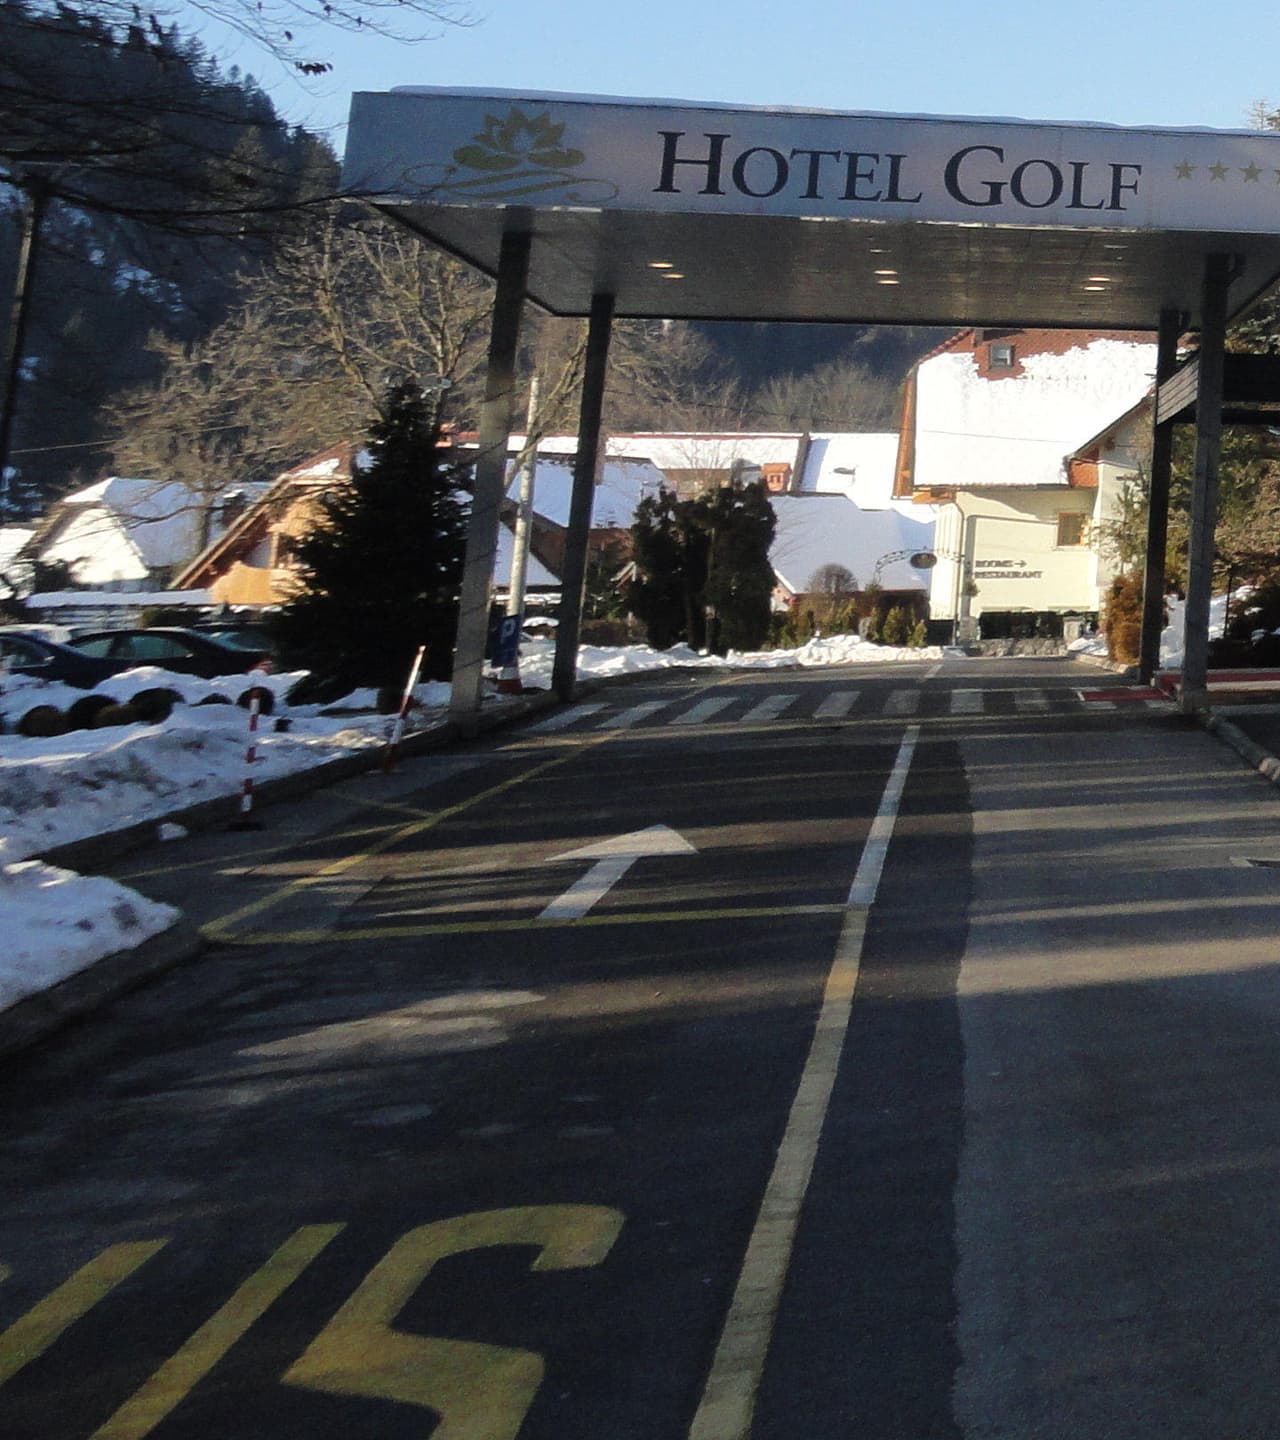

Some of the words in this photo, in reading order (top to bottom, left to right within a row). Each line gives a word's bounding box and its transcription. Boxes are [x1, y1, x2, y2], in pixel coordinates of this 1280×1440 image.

[652, 130, 922, 205] HOTEL
[944, 144, 1143, 211] GOLF
[0, 1204, 625, 1440] US
